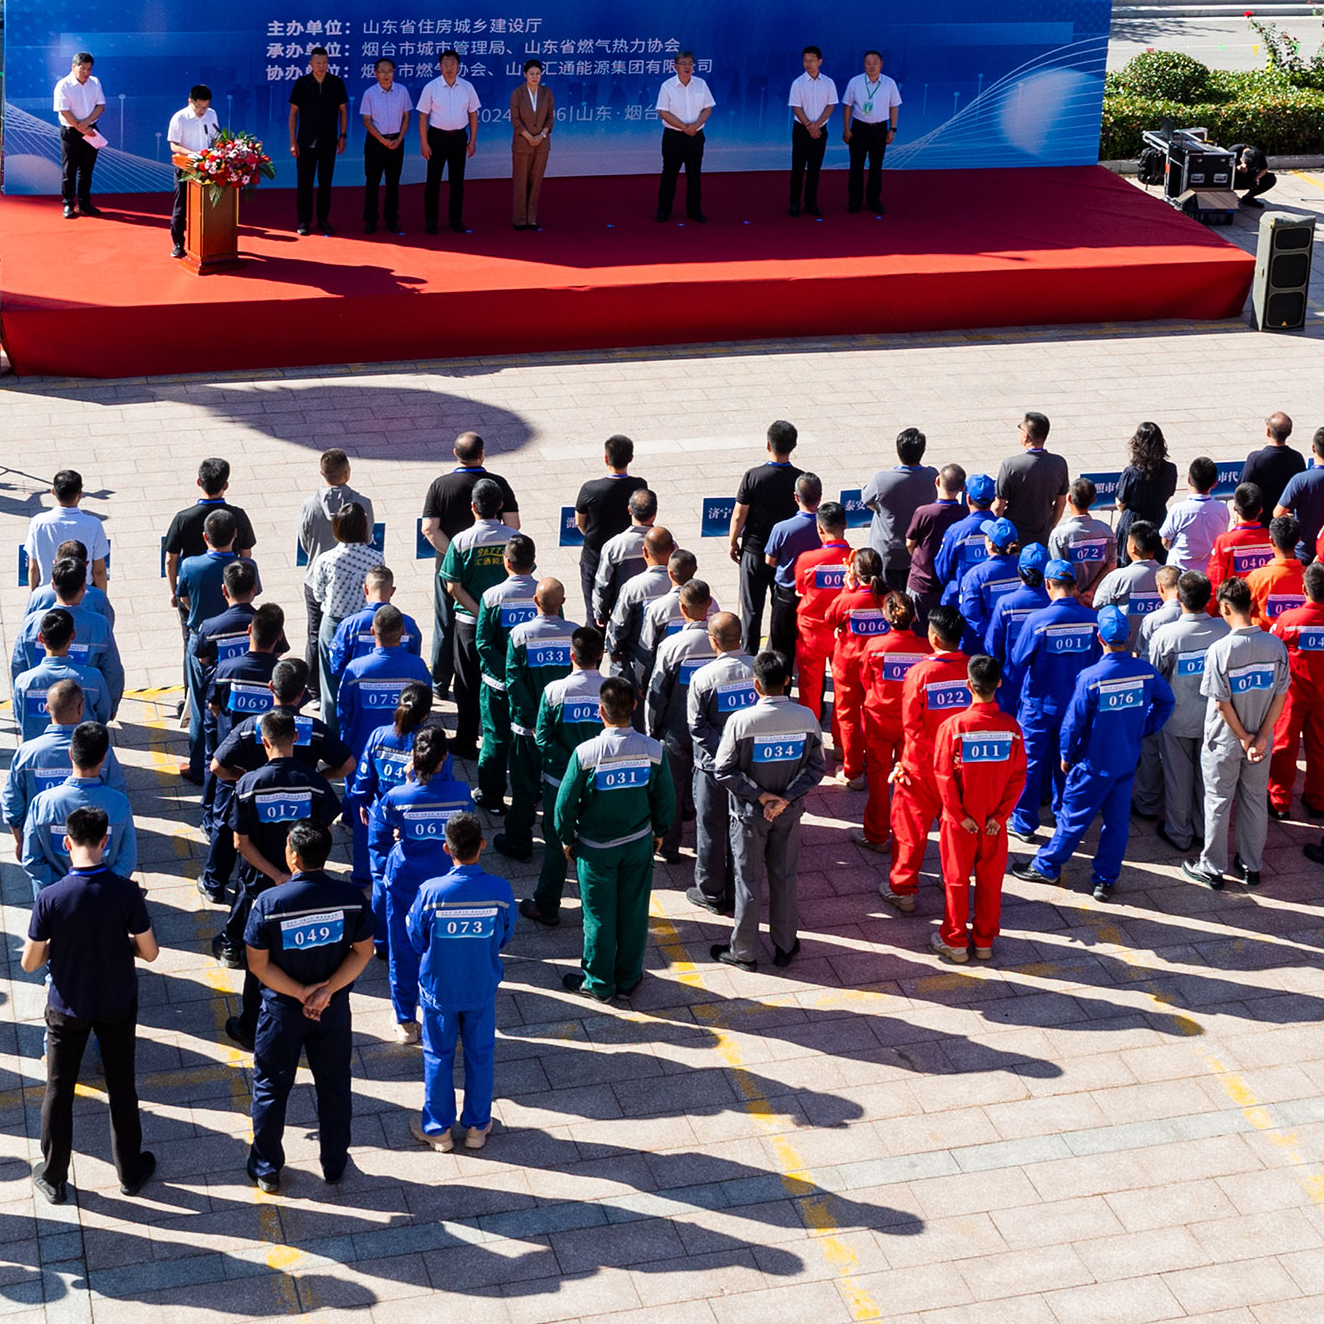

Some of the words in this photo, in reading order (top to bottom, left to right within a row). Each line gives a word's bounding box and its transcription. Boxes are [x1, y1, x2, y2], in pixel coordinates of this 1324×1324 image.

[267, 19, 351, 37] 主办单位：
[362, 17, 543, 35] 山东省住房城乡建设厅
[361, 37, 681, 57] 烟台市城市管理局、山东省燃气热力协会
[1077, 547, 1099, 560] 072
[858, 621, 886, 633] 006
[1056, 637, 1083, 650] 001
[536, 651, 564, 663] 033
[1238, 675, 1262, 690] 071
[237, 695, 268, 711] 069
[368, 692, 400, 706] 075
[936, 690, 965, 705] 022
[1108, 692, 1134, 706] 076
[763, 744, 795, 759] 034
[971, 743, 1000, 758] 011
[605, 771, 638, 786] 031
[266, 803, 299, 819] 017
[294, 925, 331, 945] 049
[446, 919, 484, 936] 073
